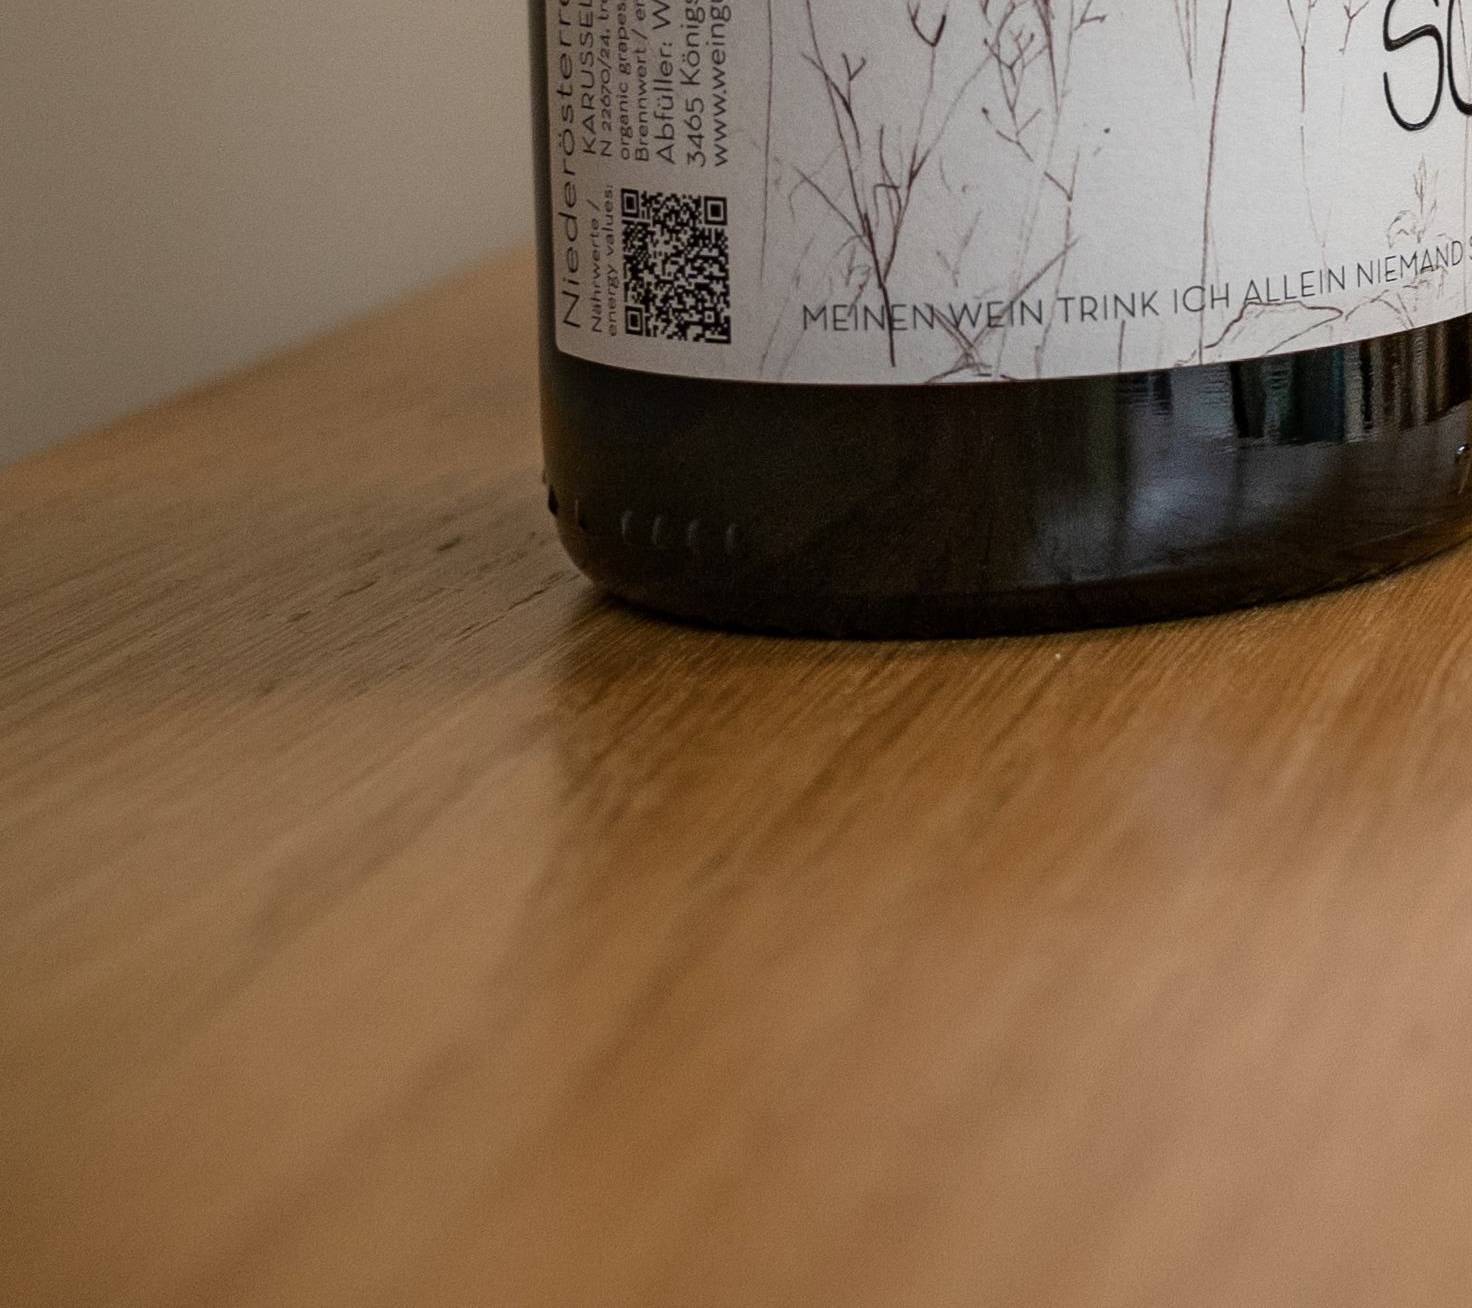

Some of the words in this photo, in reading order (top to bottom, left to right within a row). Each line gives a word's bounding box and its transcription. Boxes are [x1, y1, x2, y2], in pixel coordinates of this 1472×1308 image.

[632, 28, 648, 40] /
[616, 82, 633, 161] organic
[634, 48, 650, 163] Brennwert
[653, 42, 676, 165] Abfüller:
[683, 97, 706, 169] 3465
[599, 139, 612, 158] N
[586, 198, 600, 212] /
[588, 217, 602, 333] Nährwerte
[603, 266, 619, 338] energy
[802, 304, 935, 332] MEINEN
[949, 300, 1043, 329] WEIN
[1057, 289, 1160, 324] TRINK
[1173, 283, 1230, 314] ICH
[1243, 265, 1346, 304] ALLEIN
[1357, 240, 1464, 288] NIEMAND
